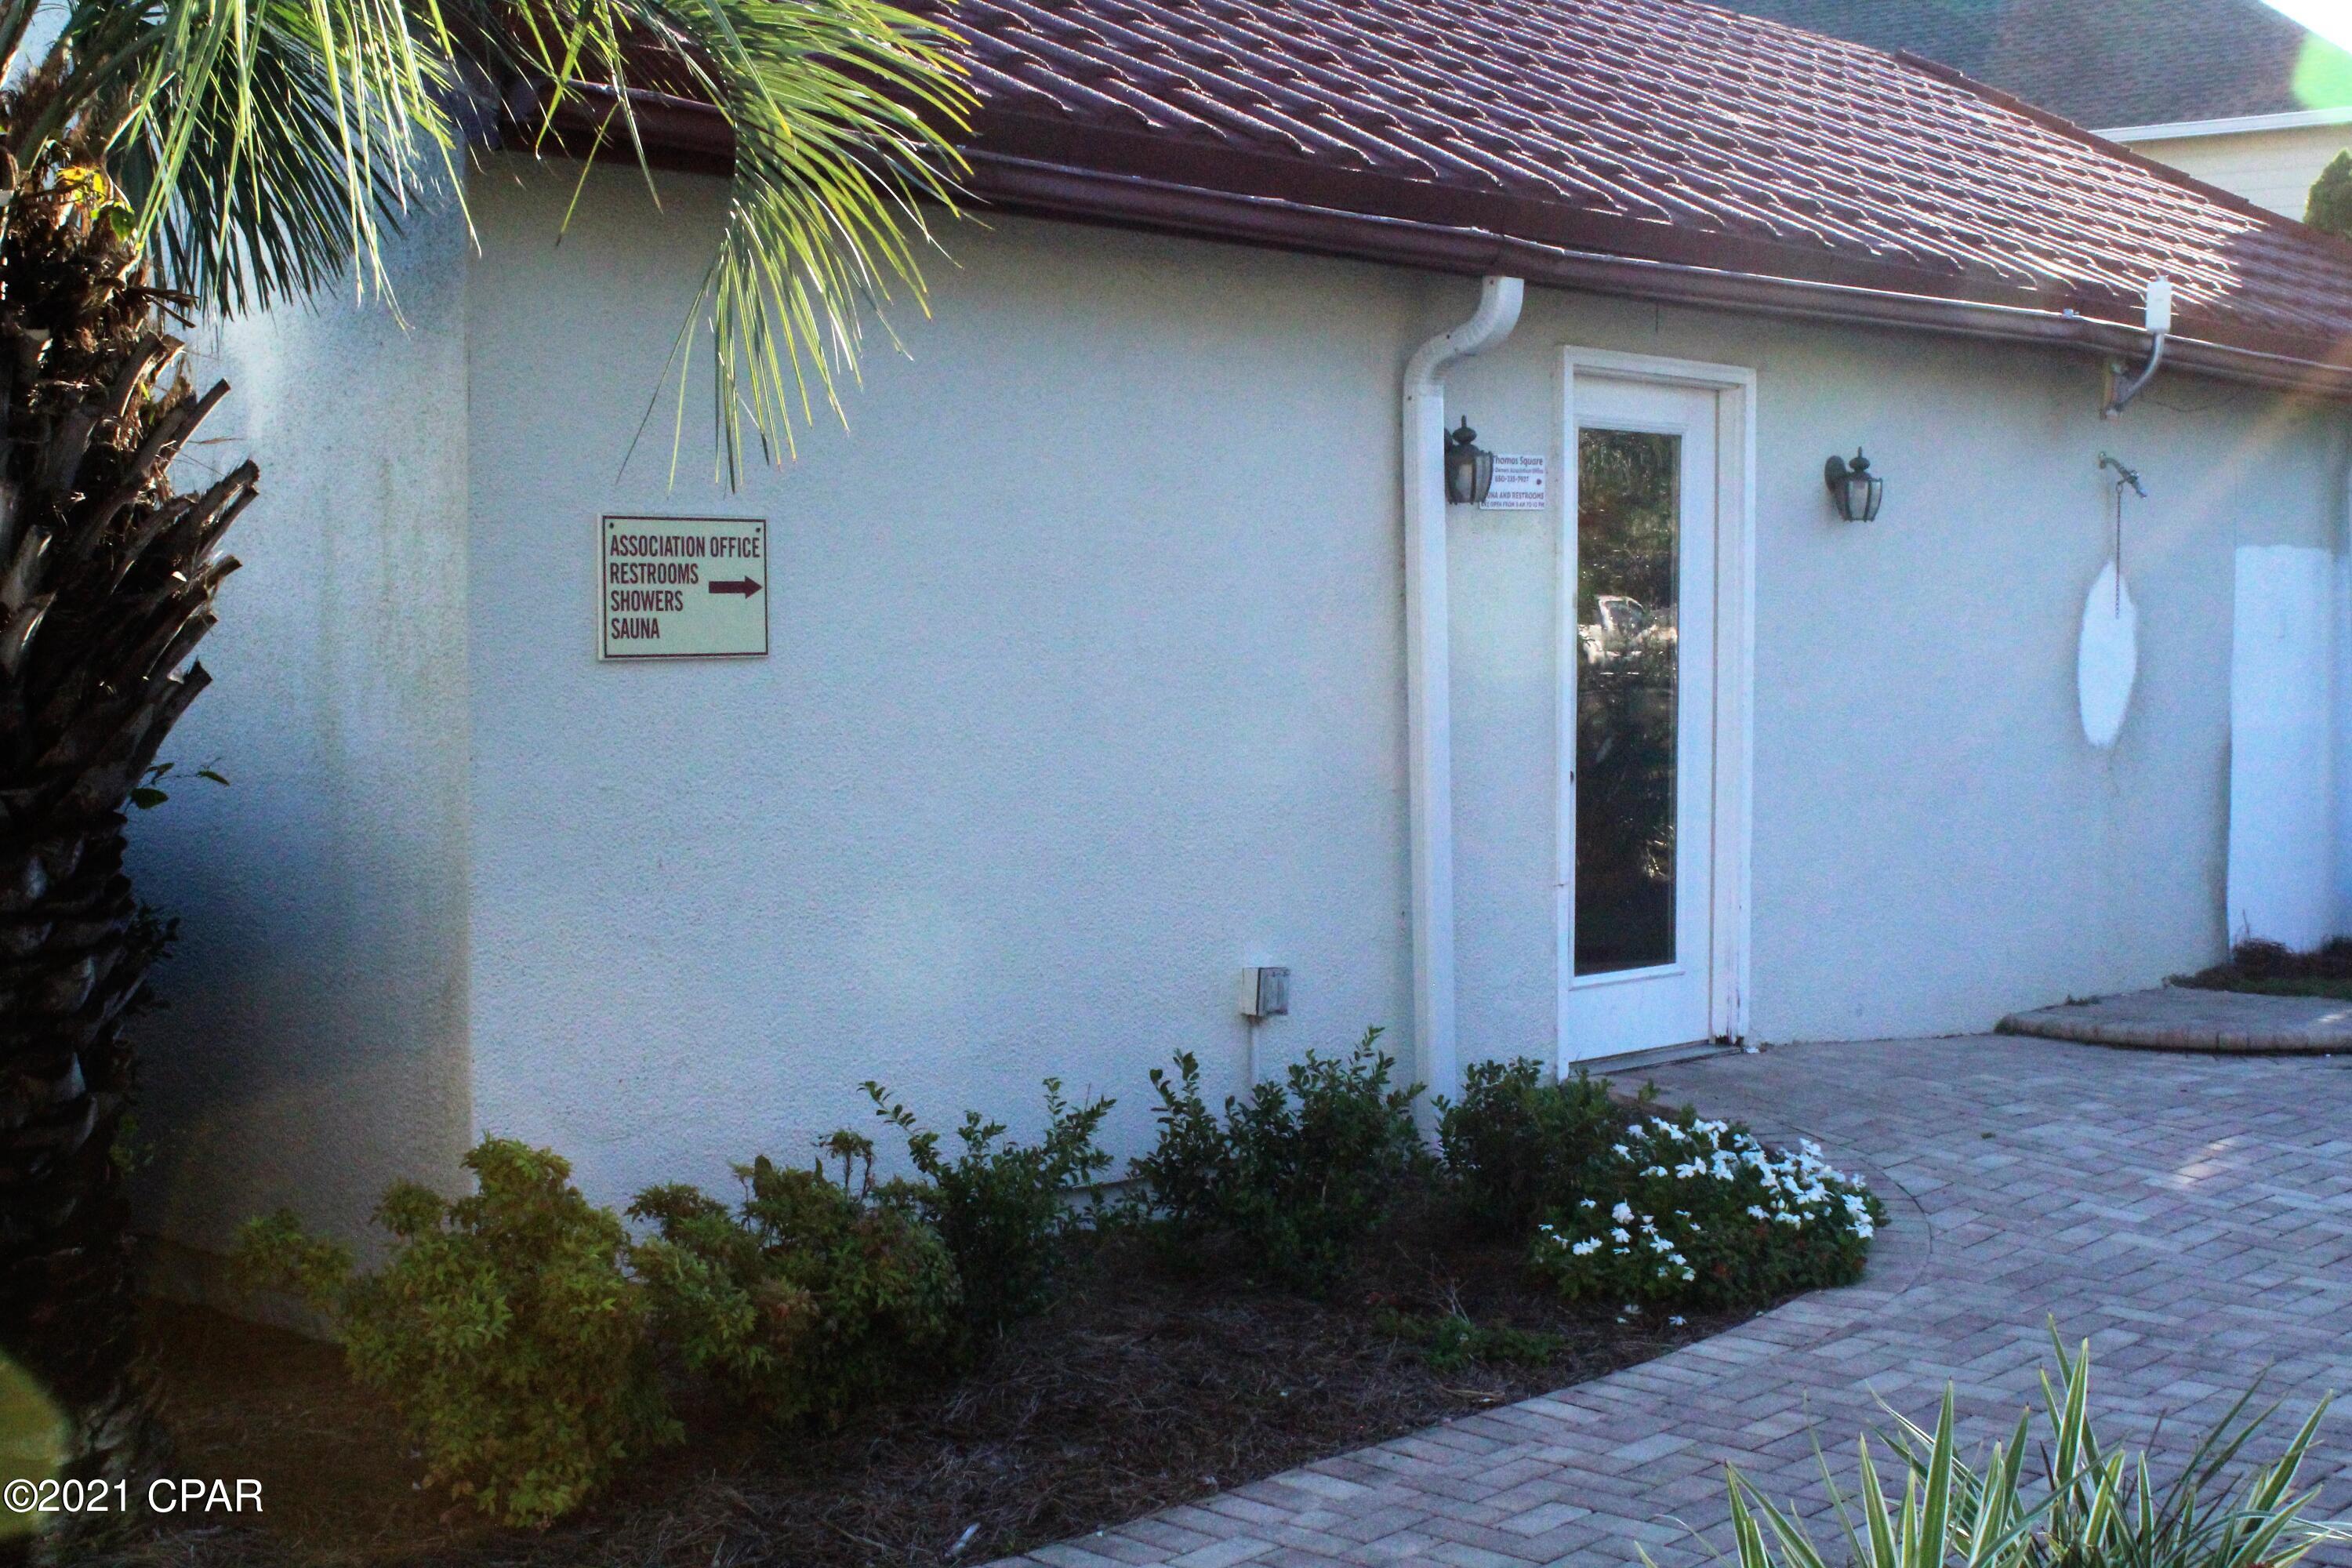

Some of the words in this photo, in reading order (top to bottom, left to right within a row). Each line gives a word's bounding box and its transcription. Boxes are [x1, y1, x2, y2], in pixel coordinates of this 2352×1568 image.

[1520, 456, 1543, 466] Square
[610, 535, 705, 557] ASSOCIATION
[710, 536, 760, 558] OFFICE
[610, 562, 699, 584] RESTROOMS
[611, 590, 684, 612] SHOWERS
[611, 617, 660, 640] SAUNA
